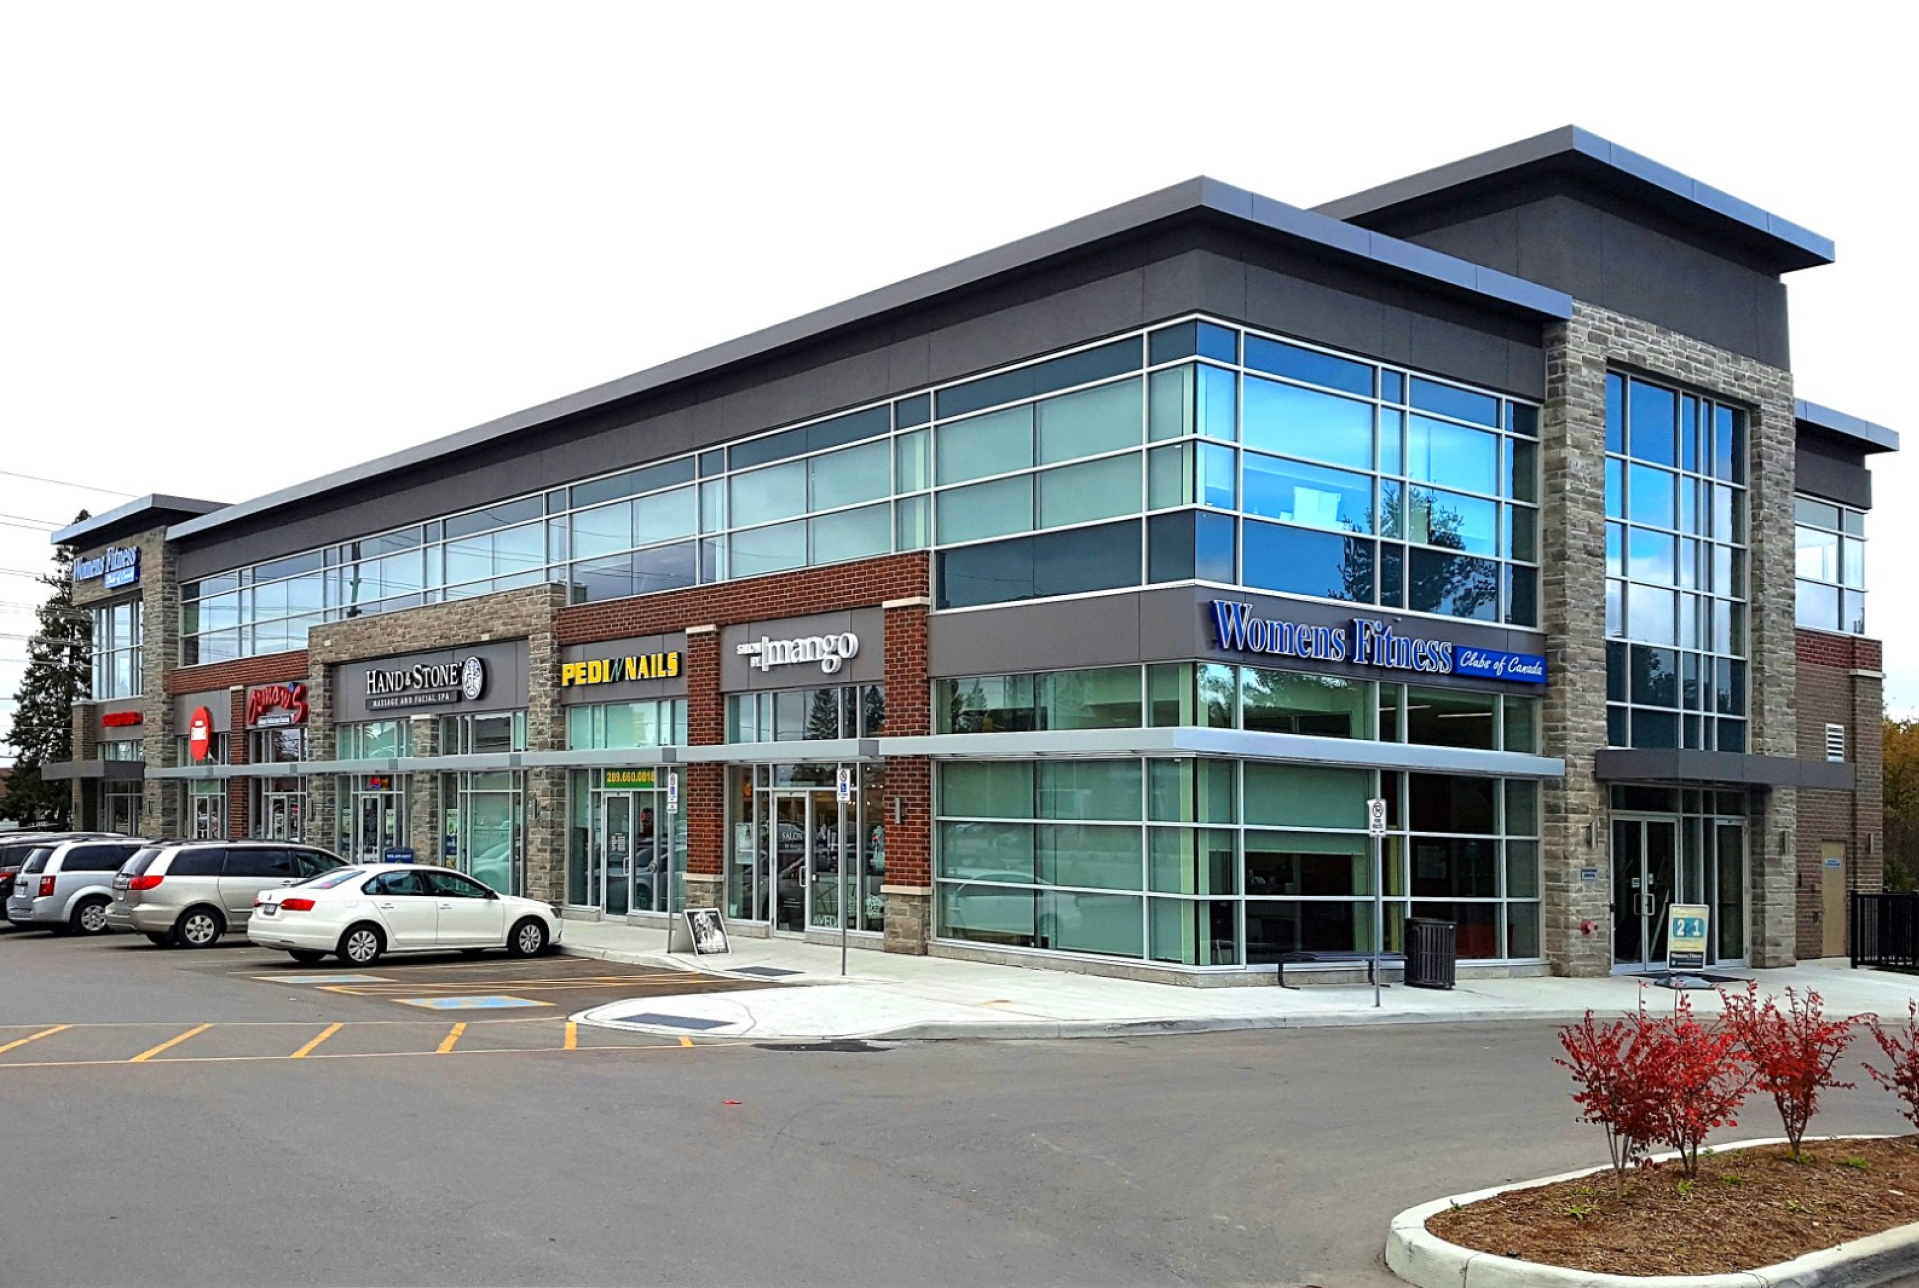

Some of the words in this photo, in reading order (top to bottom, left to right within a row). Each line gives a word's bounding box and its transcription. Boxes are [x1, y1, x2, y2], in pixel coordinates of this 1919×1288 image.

[768, 632, 859, 673] mango
[1212, 599, 1346, 662] Womens
[1352, 617, 1453, 675] Fitness
[366, 670, 404, 694] HAND
[412, 664, 459, 689] STONE
[561, 659, 611, 687] PEDI
[624, 651, 679, 681] NAILS
[1459, 650, 1490, 669] Clubs
[1493, 655, 1507, 676] of
[1507, 656, 1543, 677] Canada
[438, 692, 451, 701] SPA
